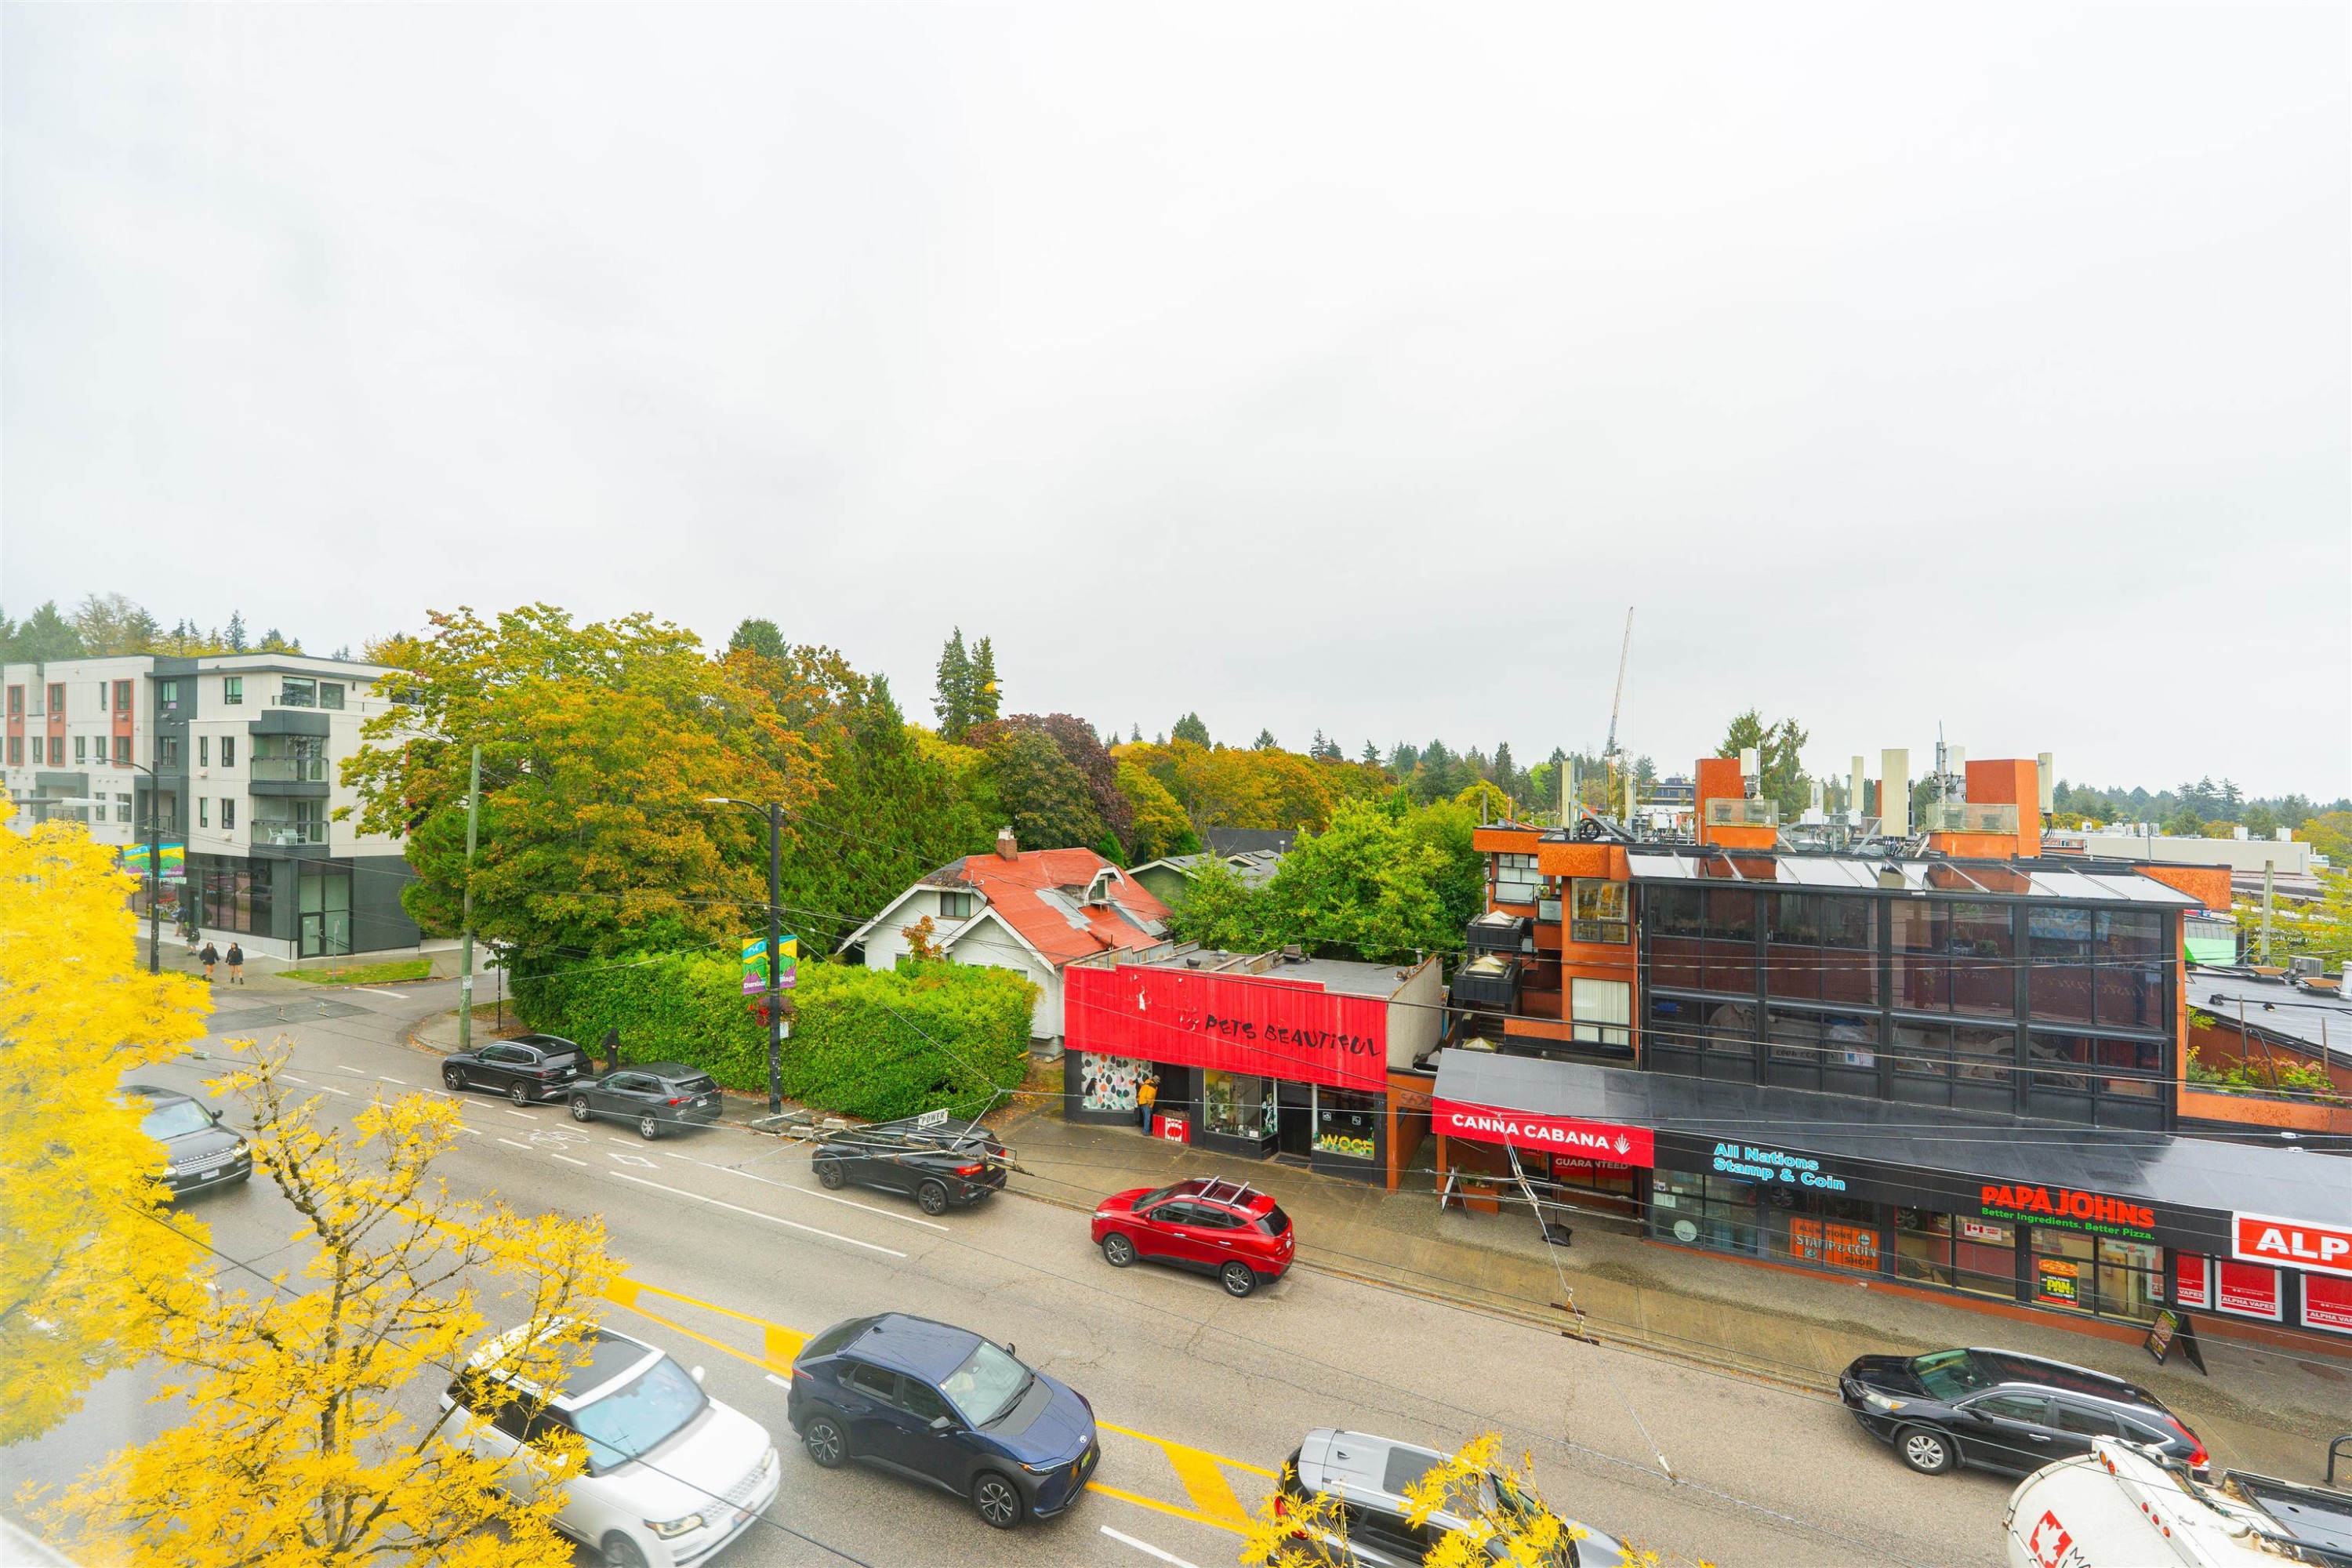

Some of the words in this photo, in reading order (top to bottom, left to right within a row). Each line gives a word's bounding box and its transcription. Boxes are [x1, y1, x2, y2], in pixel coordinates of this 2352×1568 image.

[1205, 1014, 1257, 1040] PETS
[921, 1112, 945, 1125] POWER
[1452, 1113, 1520, 1136] CANNA
[1523, 1124, 1610, 1150] CABANA
[1714, 1143, 1740, 1159] All
[1744, 1147, 1819, 1171] Nations
[1713, 1157, 1774, 1181] Stamp
[1780, 1168, 1796, 1182] &
[1800, 1172, 1846, 1191] Coin
[1981, 1185, 2053, 1214] PAPA
[2056, 1189, 2155, 1229] JOHNS
[1815, 1228, 1853, 1239] NTIONS
[1981, 1207, 2015, 1220] Better
[2017, 1212, 2082, 1230] Ingredients.
[2085, 1222, 2120, 1236] Better
[2122, 1227, 2155, 1240] Pizza.
[1847, 1243, 1878, 1258] COIN
[2256, 1228, 2350, 1261] ALP
[1844, 1256, 1873, 1267] SHOP
[2179, 1288, 2204, 1298] VAPES
[2222, 1296, 2248, 1306] ALPHA
[2249, 1299, 2275, 1310] VAPES
[2310, 1311, 2337, 1322] ALPHA
